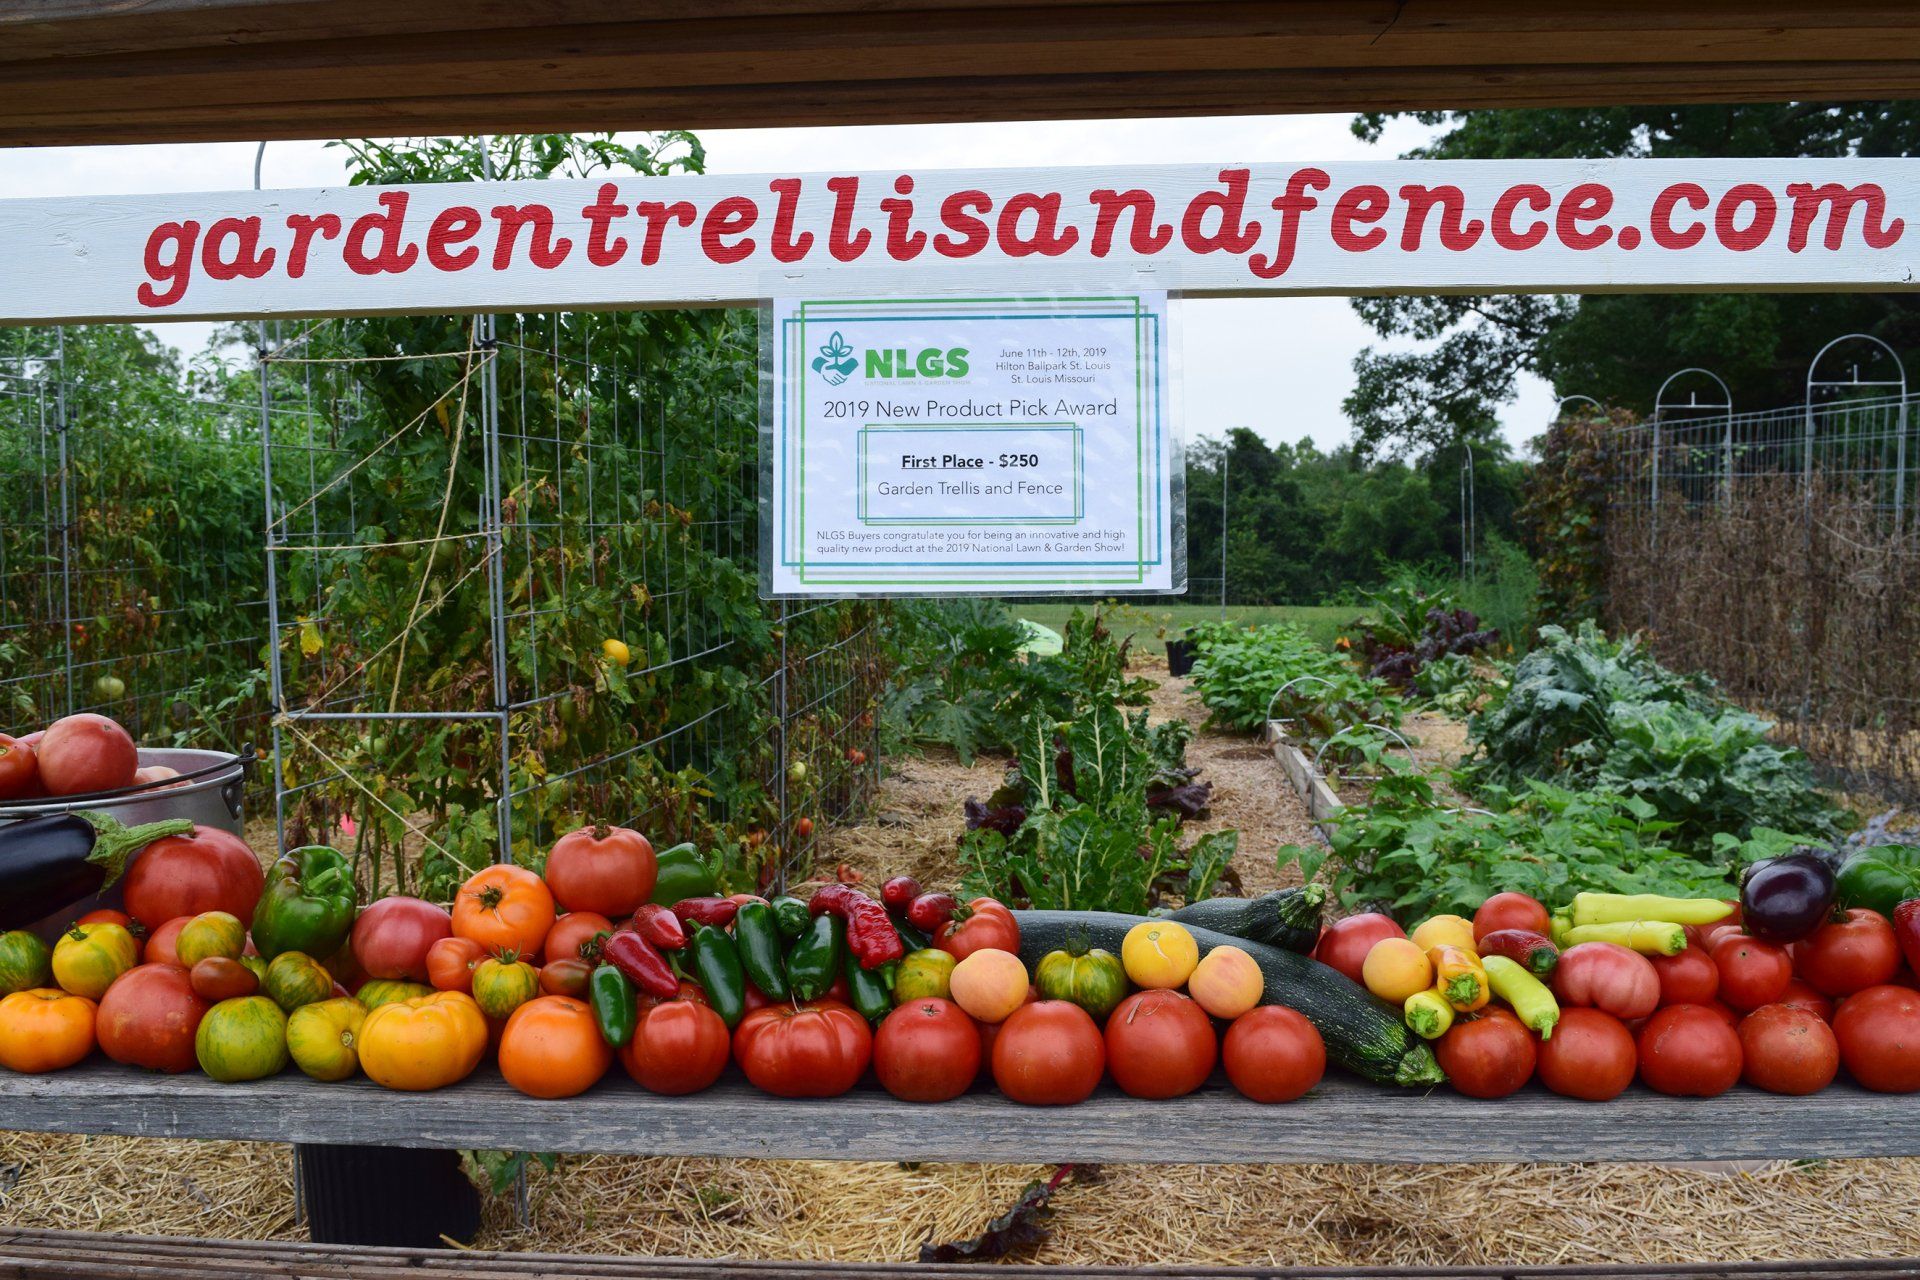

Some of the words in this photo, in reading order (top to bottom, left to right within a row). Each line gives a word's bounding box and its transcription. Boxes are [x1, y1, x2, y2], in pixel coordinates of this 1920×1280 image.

[138, 168, 1905, 307] gardentrellisandfence.com
[1000, 349, 1023, 358] June
[1027, 348, 1047, 358] 11th
[1057, 347, 1080, 358] 12th,
[1083, 347, 1107, 357] 2019
[865, 347, 970, 379] NLGS
[996, 361, 1025, 371] Hilton
[1070, 361, 1083, 370] St.
[1086, 361, 1111, 370] Louis
[1011, 374, 1024, 384] St.
[1027, 374, 1052, 384] Louis
[1055, 373, 1096, 383] Missouri
[823, 401, 869, 418] 2019
[876, 401, 920, 418] New
[927, 399, 1003, 417] Product
[1010, 398, 1048, 416] Pick
[1054, 398, 1118, 416] Award
[901, 455, 939, 469] First
[942, 454, 984, 469] Place
[999, 453, 1040, 469] $250
[878, 481, 933, 496] Garden
[938, 481, 980, 495] Trellis
[985, 481, 1013, 495] and
[1017, 481, 1063, 495] Fence
[817, 531, 846, 540] NLGS
[848, 531, 881, 542] Buyers
[883, 531, 945, 541] congratulate
[947, 532, 965, 541] you
[967, 530, 981, 540] for
[984, 530, 1013, 541] being
[1015, 532, 1027, 540] an
[1029, 530, 1079, 539] innovative
[1082, 530, 1101, 539] and
[1103, 529, 1126, 541] high
[817, 544, 850, 555] quality
[852, 545, 873, 553] new
[874, 543, 913, 554] product
[915, 544, 925, 553] at
[928, 543, 943, 553] the
[946, 543, 970, 553] 2019
[972, 543, 1014, 553] National
[1016, 543, 1041, 552] Lawn
[1044, 542, 1052, 552] &
[1054, 542, 1092, 552] Garden
[1094, 542, 1126, 552] Show!
